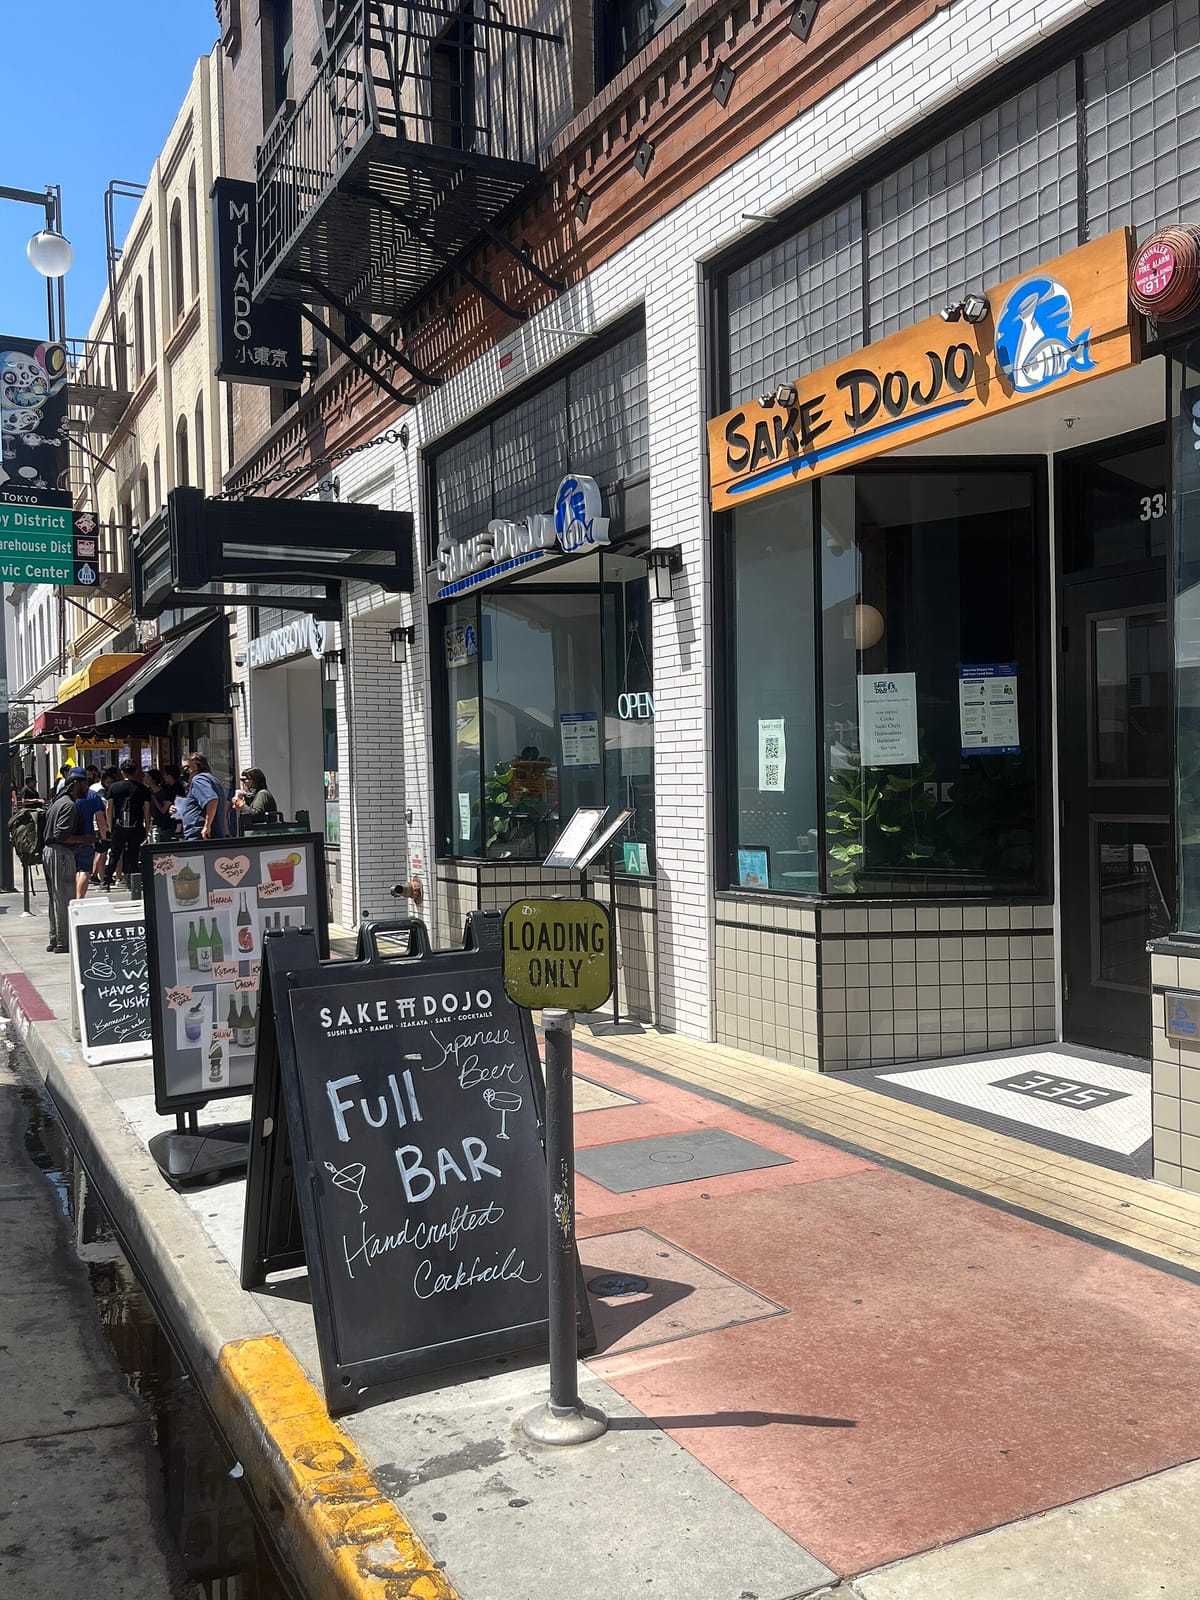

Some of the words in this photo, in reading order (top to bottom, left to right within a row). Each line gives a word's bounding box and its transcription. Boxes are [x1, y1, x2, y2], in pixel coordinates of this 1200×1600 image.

[229, 199, 252, 341] MIKADO
[1138, 245, 1169, 267] SPRINKLER
[1138, 264, 1151, 275] FIRE
[1152, 254, 1171, 268] ALARM
[235, 343, 289, 368] 小東京
[725, 393, 833, 474] SAKE
[835, 341, 976, 432] DOJO
[2, 492, 38, 504] TOKYO
[1139, 491, 1168, 521] 33
[14, 512, 66, 529] District
[50, 540, 72, 554] Dist
[25, 564, 70, 579] Center
[247, 613, 313, 668] TEAMORROW
[617, 691, 656, 720] OPEN
[628, 850, 640, 872] A
[89, 928, 122, 940] SAKE
[508, 921, 604, 953] LOADING
[528, 957, 584, 989] ONLY
[320, 1000, 389, 1028] SAKE
[423, 989, 493, 1016] DOJO
[327, 1030, 347, 1038] SUSHI
[370, 1023, 394, 1032] RAMEN
[400, 1019, 429, 1029] IZAKAYA
[435, 1016, 452, 1025] SAKE
[458, 1011, 493, 1021] COCKTAILS
[422, 1028, 516, 1072] Japanese
[459, 1054, 524, 1090] Beer
[326, 1067, 424, 1143] Full
[1007, 1075, 1110, 1105] 335
[395, 1136, 502, 1203] BAR
[413, 1247, 543, 1300] Cocktails
